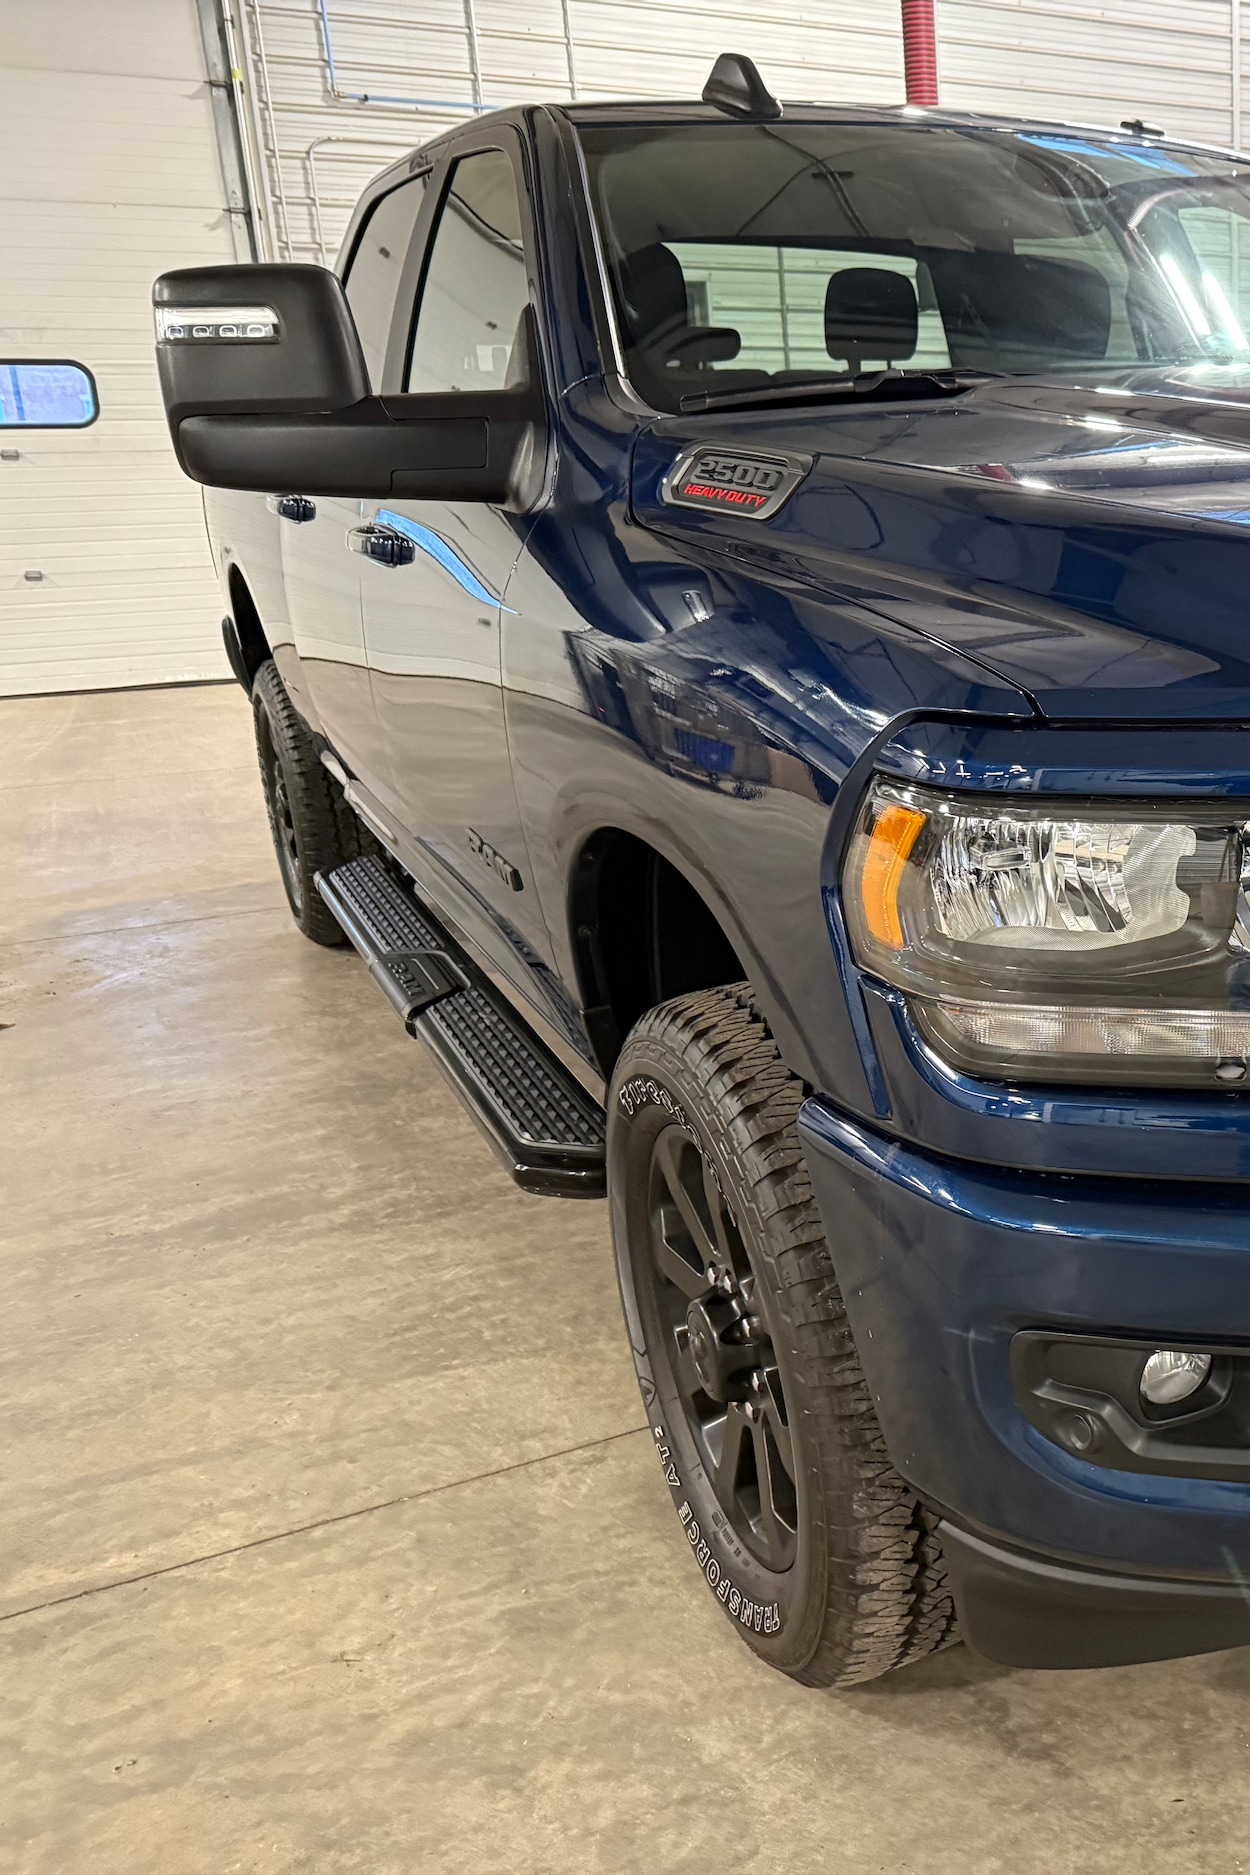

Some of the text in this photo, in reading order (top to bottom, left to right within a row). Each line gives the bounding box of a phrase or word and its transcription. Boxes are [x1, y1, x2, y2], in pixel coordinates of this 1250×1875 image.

[692, 459, 779, 490] 2500
[684, 483, 767, 507] HEAVY DUTY
[387, 960, 422, 996] RAM
[678, 1500, 781, 1633] TRANSFORCE
